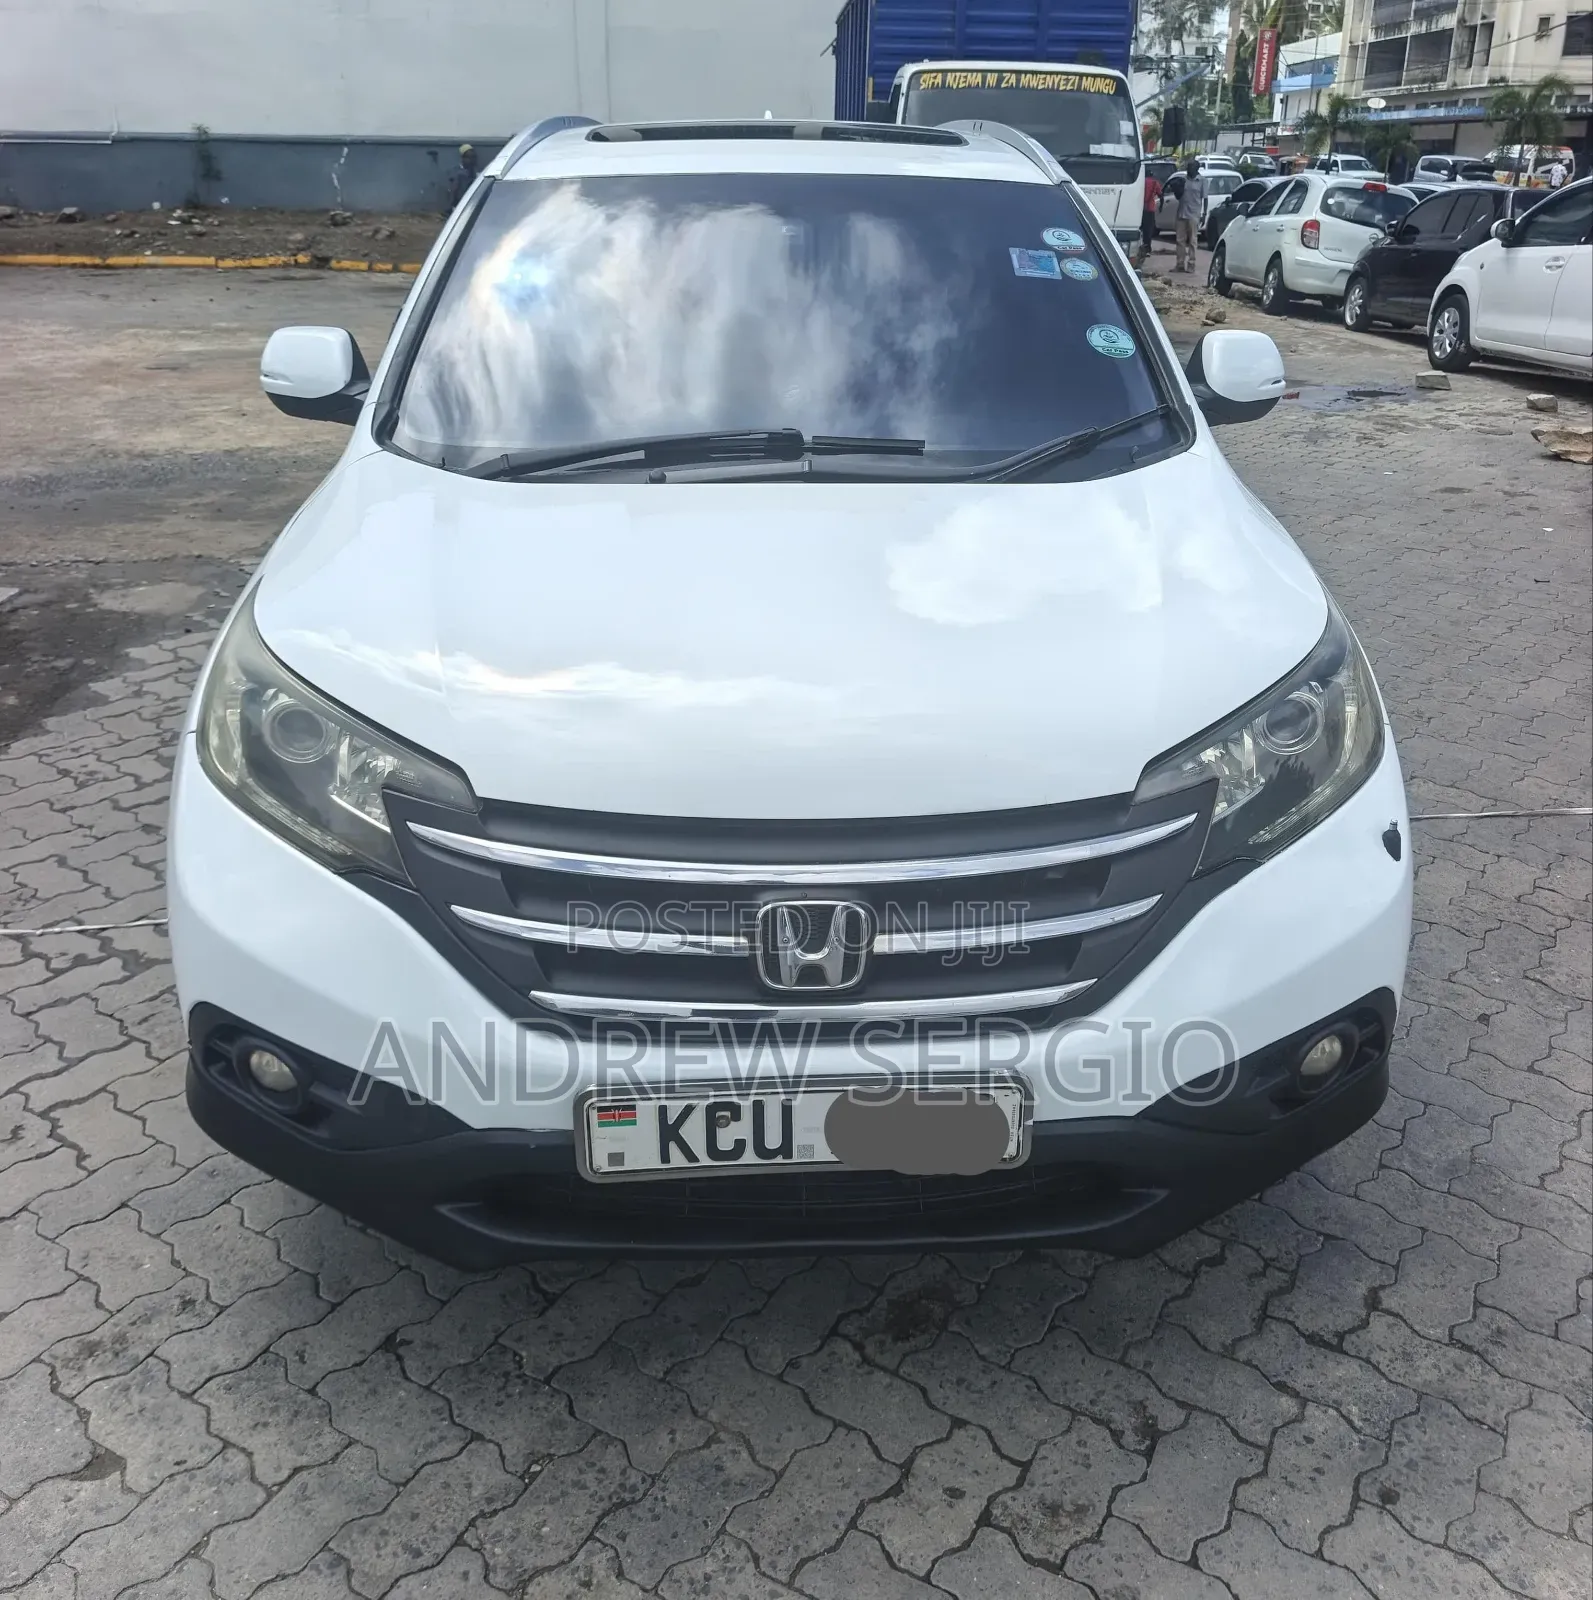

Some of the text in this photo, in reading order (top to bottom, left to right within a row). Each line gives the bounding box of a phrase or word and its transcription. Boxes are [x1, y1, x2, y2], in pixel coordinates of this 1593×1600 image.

[919, 72, 1117, 95] SIFA NJEMA NI ZA MWENYEZI MUNGU
[658, 1099, 794, 1164] KCU
